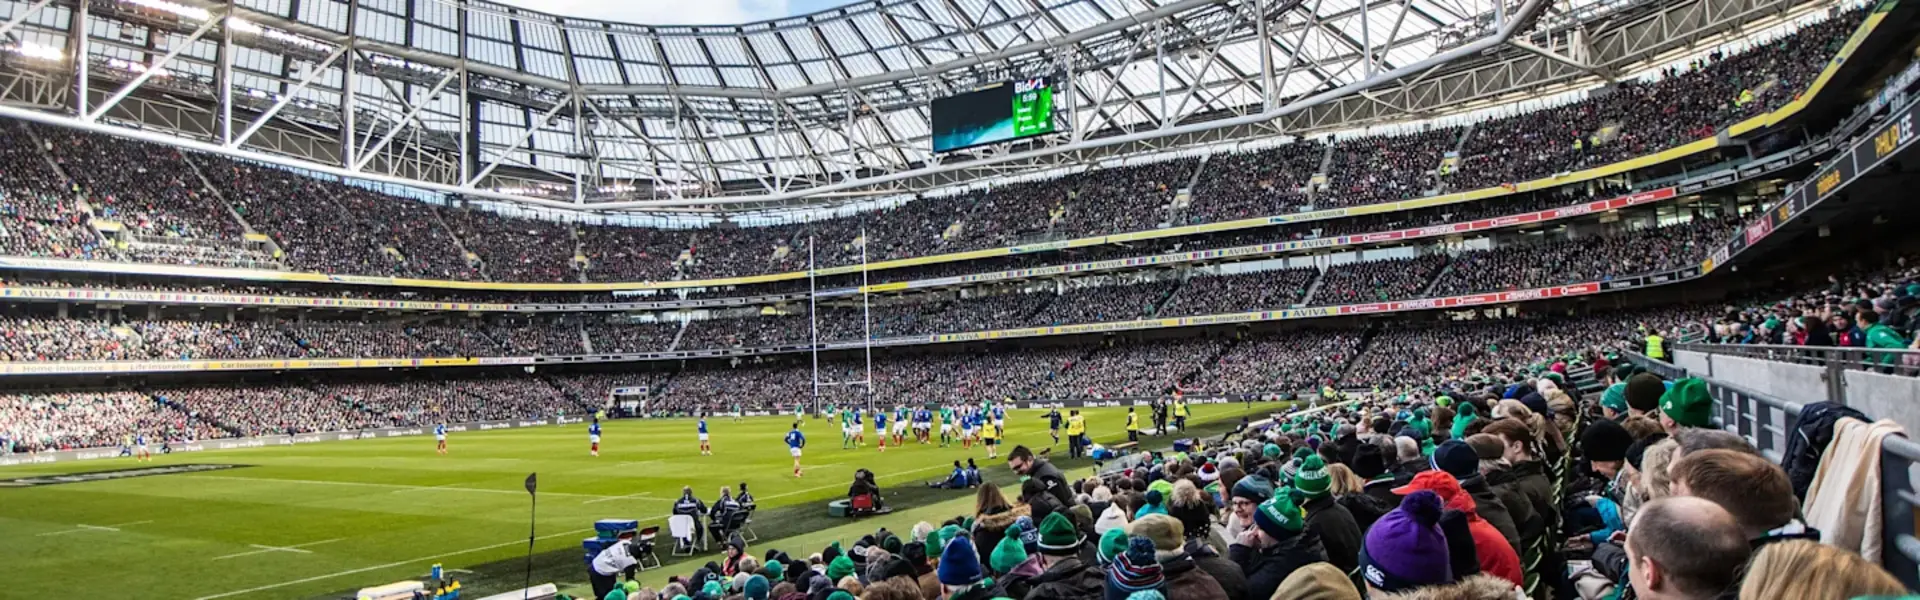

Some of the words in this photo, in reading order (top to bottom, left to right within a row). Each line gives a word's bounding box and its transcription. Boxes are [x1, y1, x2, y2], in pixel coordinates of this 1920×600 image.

[1302, 239, 1333, 249] AVIVA
[1228, 246, 1258, 256] AVIVA
[1160, 254, 1188, 262] AVIVA
[1096, 260, 1123, 269] AVIVA
[1036, 267, 1061, 275] AVIVA
[980, 273, 1004, 281] AVIVA
[20, 289, 61, 298] AVIVA
[118, 292, 154, 300] AVIVA
[203, 295, 236, 303] AVIVA
[1293, 308, 1328, 317] AVIVA
[1192, 316, 1214, 324] Home
[955, 333, 979, 341] AVIVA
